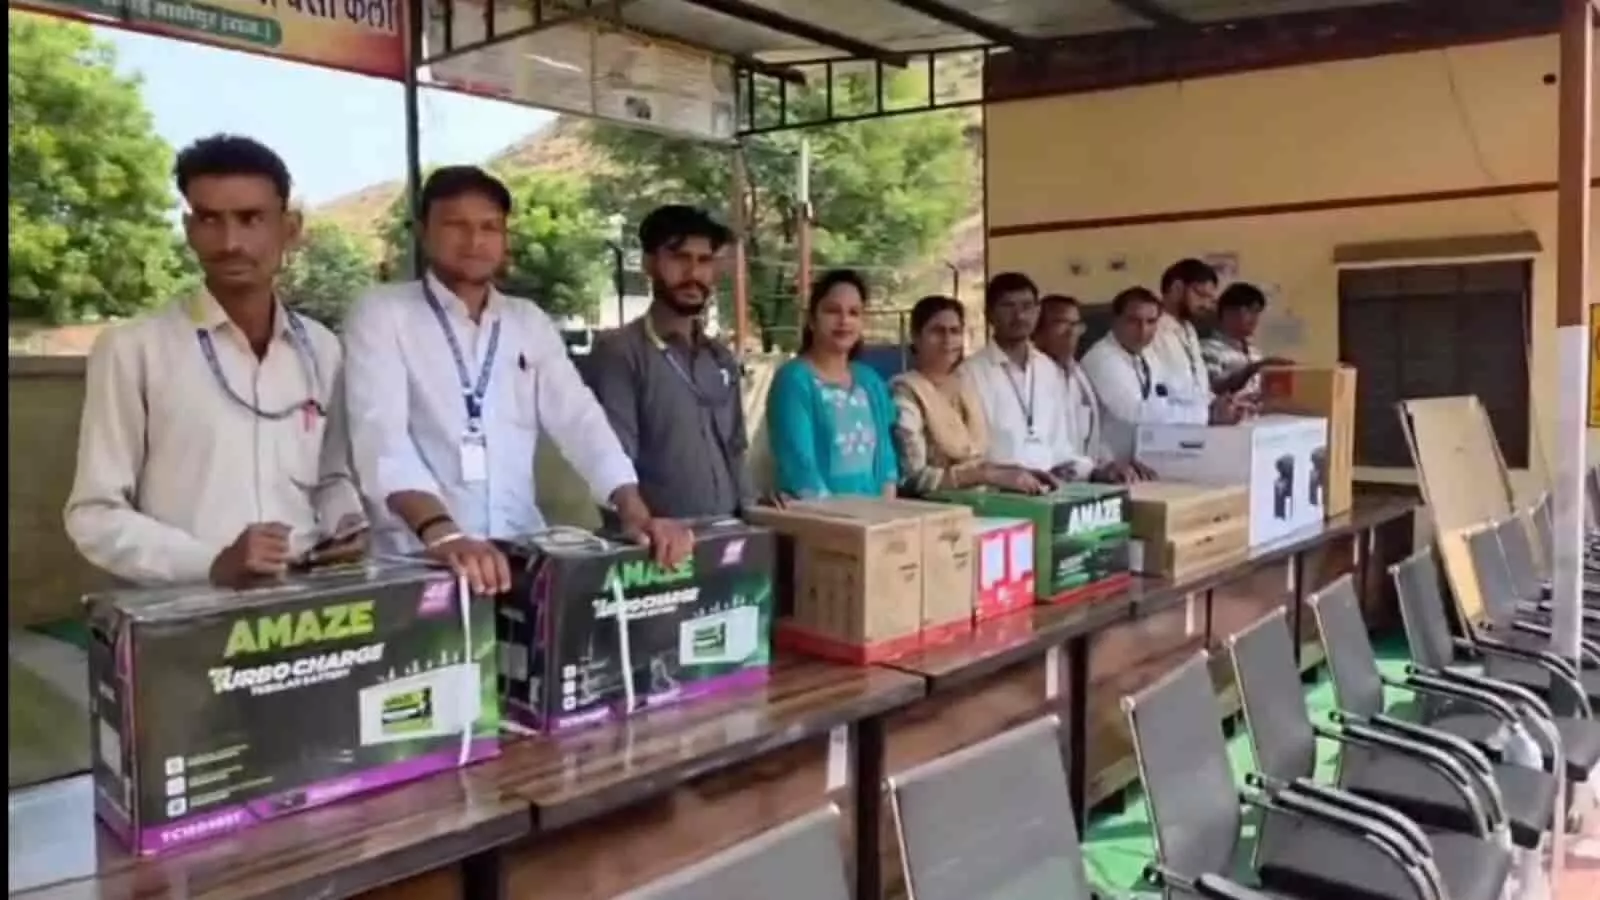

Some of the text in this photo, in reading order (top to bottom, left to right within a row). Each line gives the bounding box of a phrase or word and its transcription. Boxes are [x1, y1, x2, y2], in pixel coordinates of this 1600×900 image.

[1067, 497, 1122, 536] AMAZE
[224, 600, 375, 658] AMAZE
[292, 642, 386, 676] CHARGE
